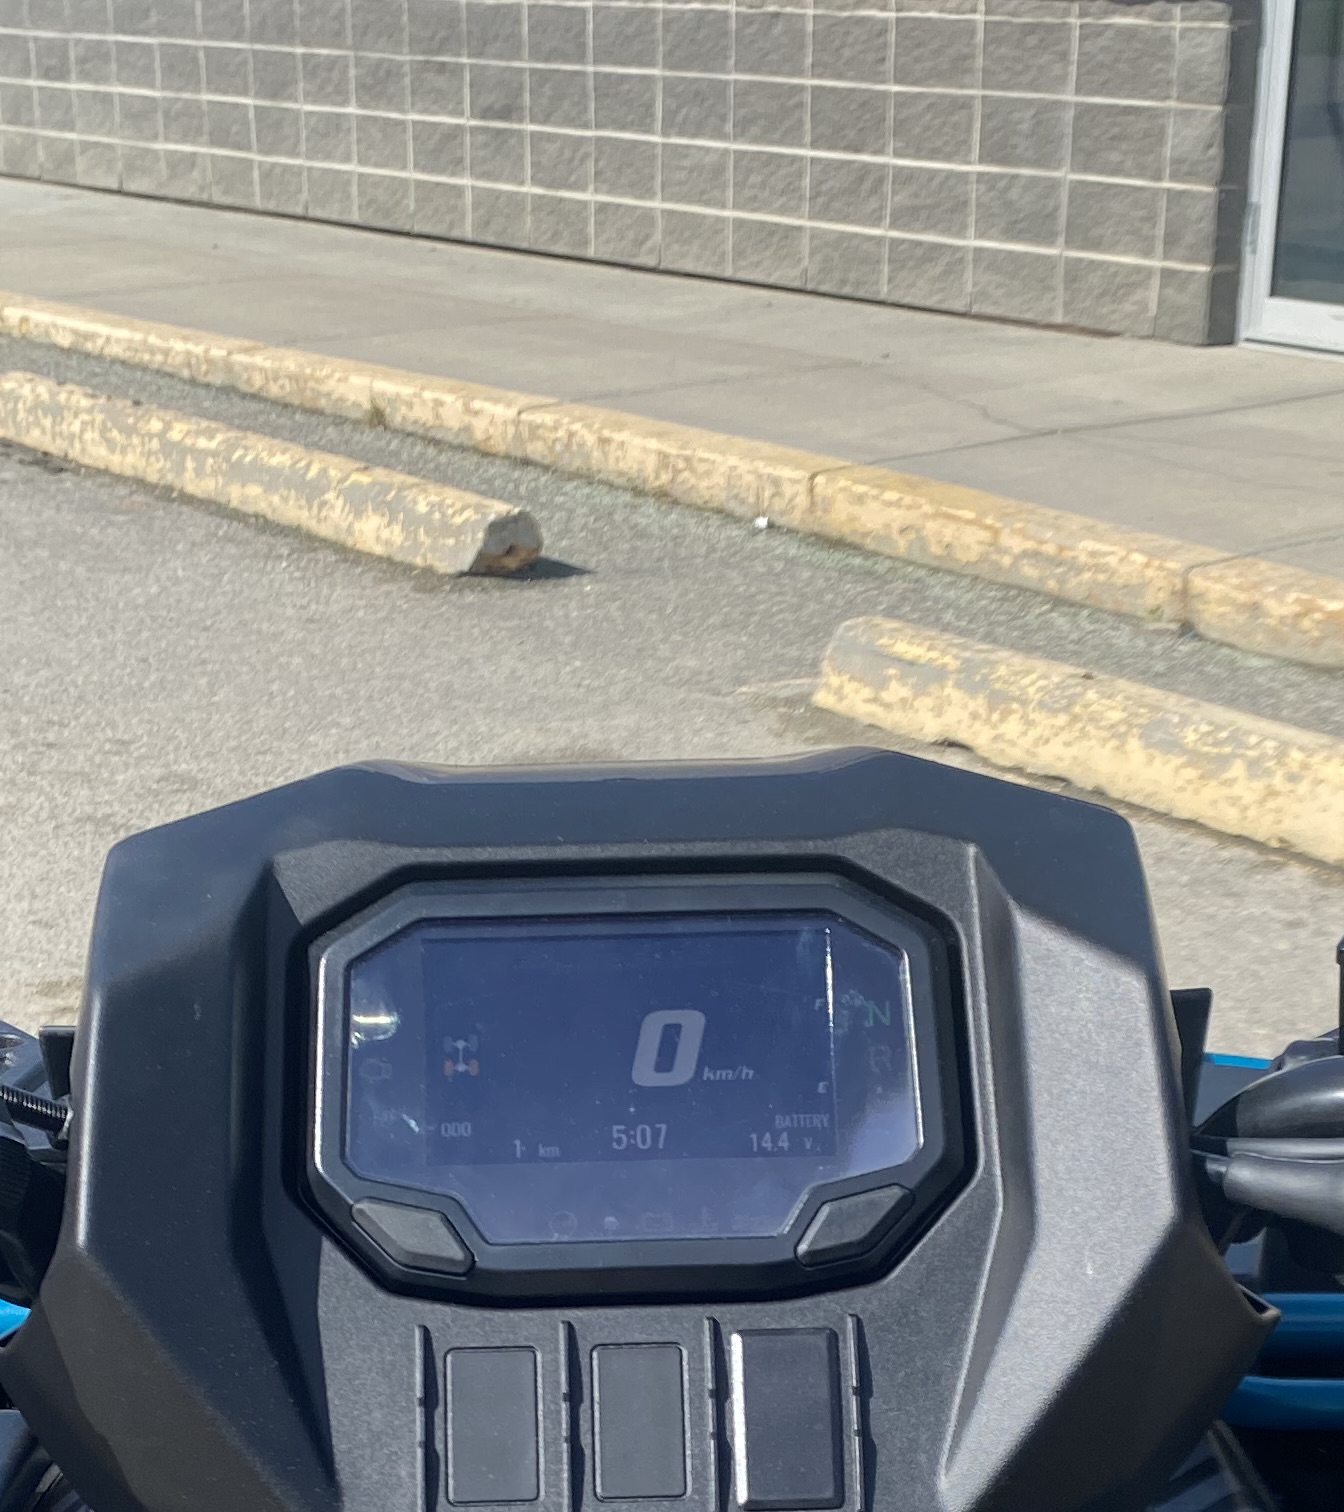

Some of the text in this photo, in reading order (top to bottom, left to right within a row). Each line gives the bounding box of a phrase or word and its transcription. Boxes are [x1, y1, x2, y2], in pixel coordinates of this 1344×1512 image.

[632, 1009, 754, 1086] 0 km/h
[775, 1113, 829, 1128] BATTERY
[612, 1124, 666, 1150] 5:07
[750, 1132, 790, 1152] 14.4
[539, 1143, 560, 1158] km
